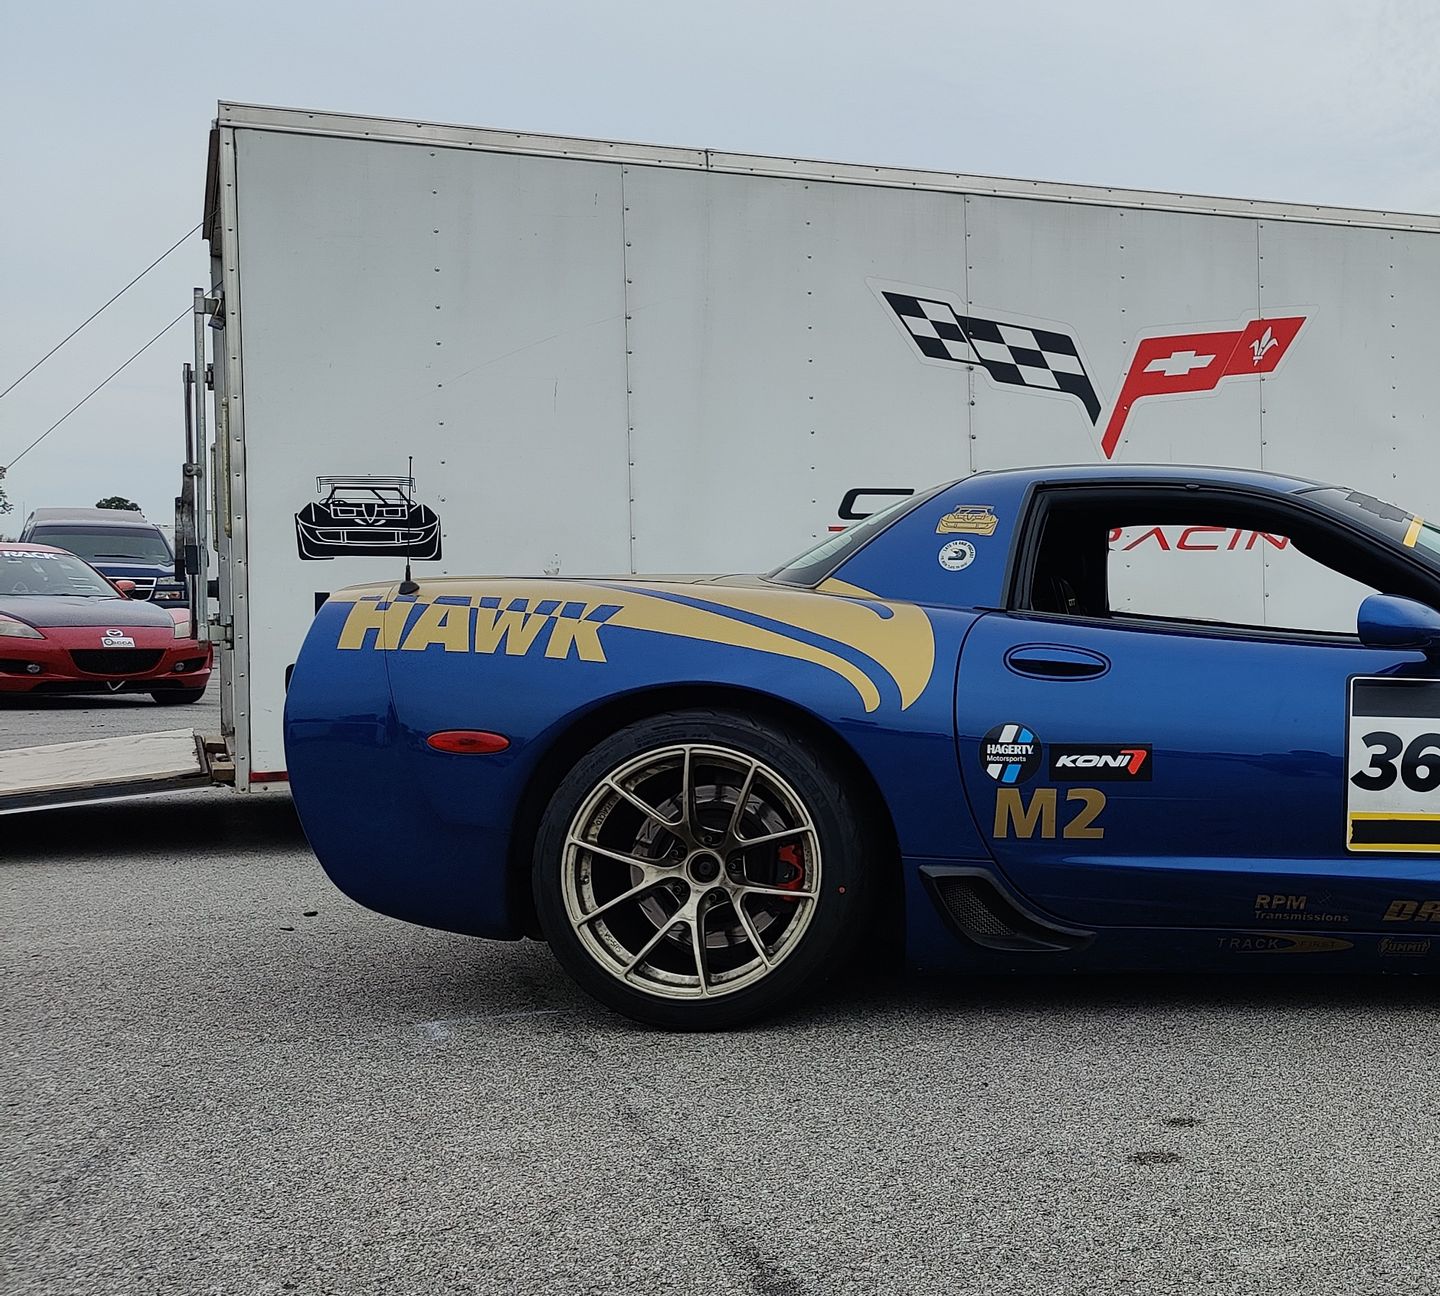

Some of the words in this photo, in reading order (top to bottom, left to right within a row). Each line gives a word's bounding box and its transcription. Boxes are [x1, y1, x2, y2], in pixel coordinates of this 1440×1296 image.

[1109, 527, 1290, 551] ACIN
[337, 596, 624, 662] HAWK
[987, 744, 1034, 755] HAGERTY
[986, 755, 1027, 763] Motorsports
[1055, 755, 1132, 767] KONI
[993, 788, 1107, 839] M2
[1255, 894, 1308, 910] RPM
[1255, 911, 1349, 923] Transmissions
[1217, 937, 1280, 950] TRACK
